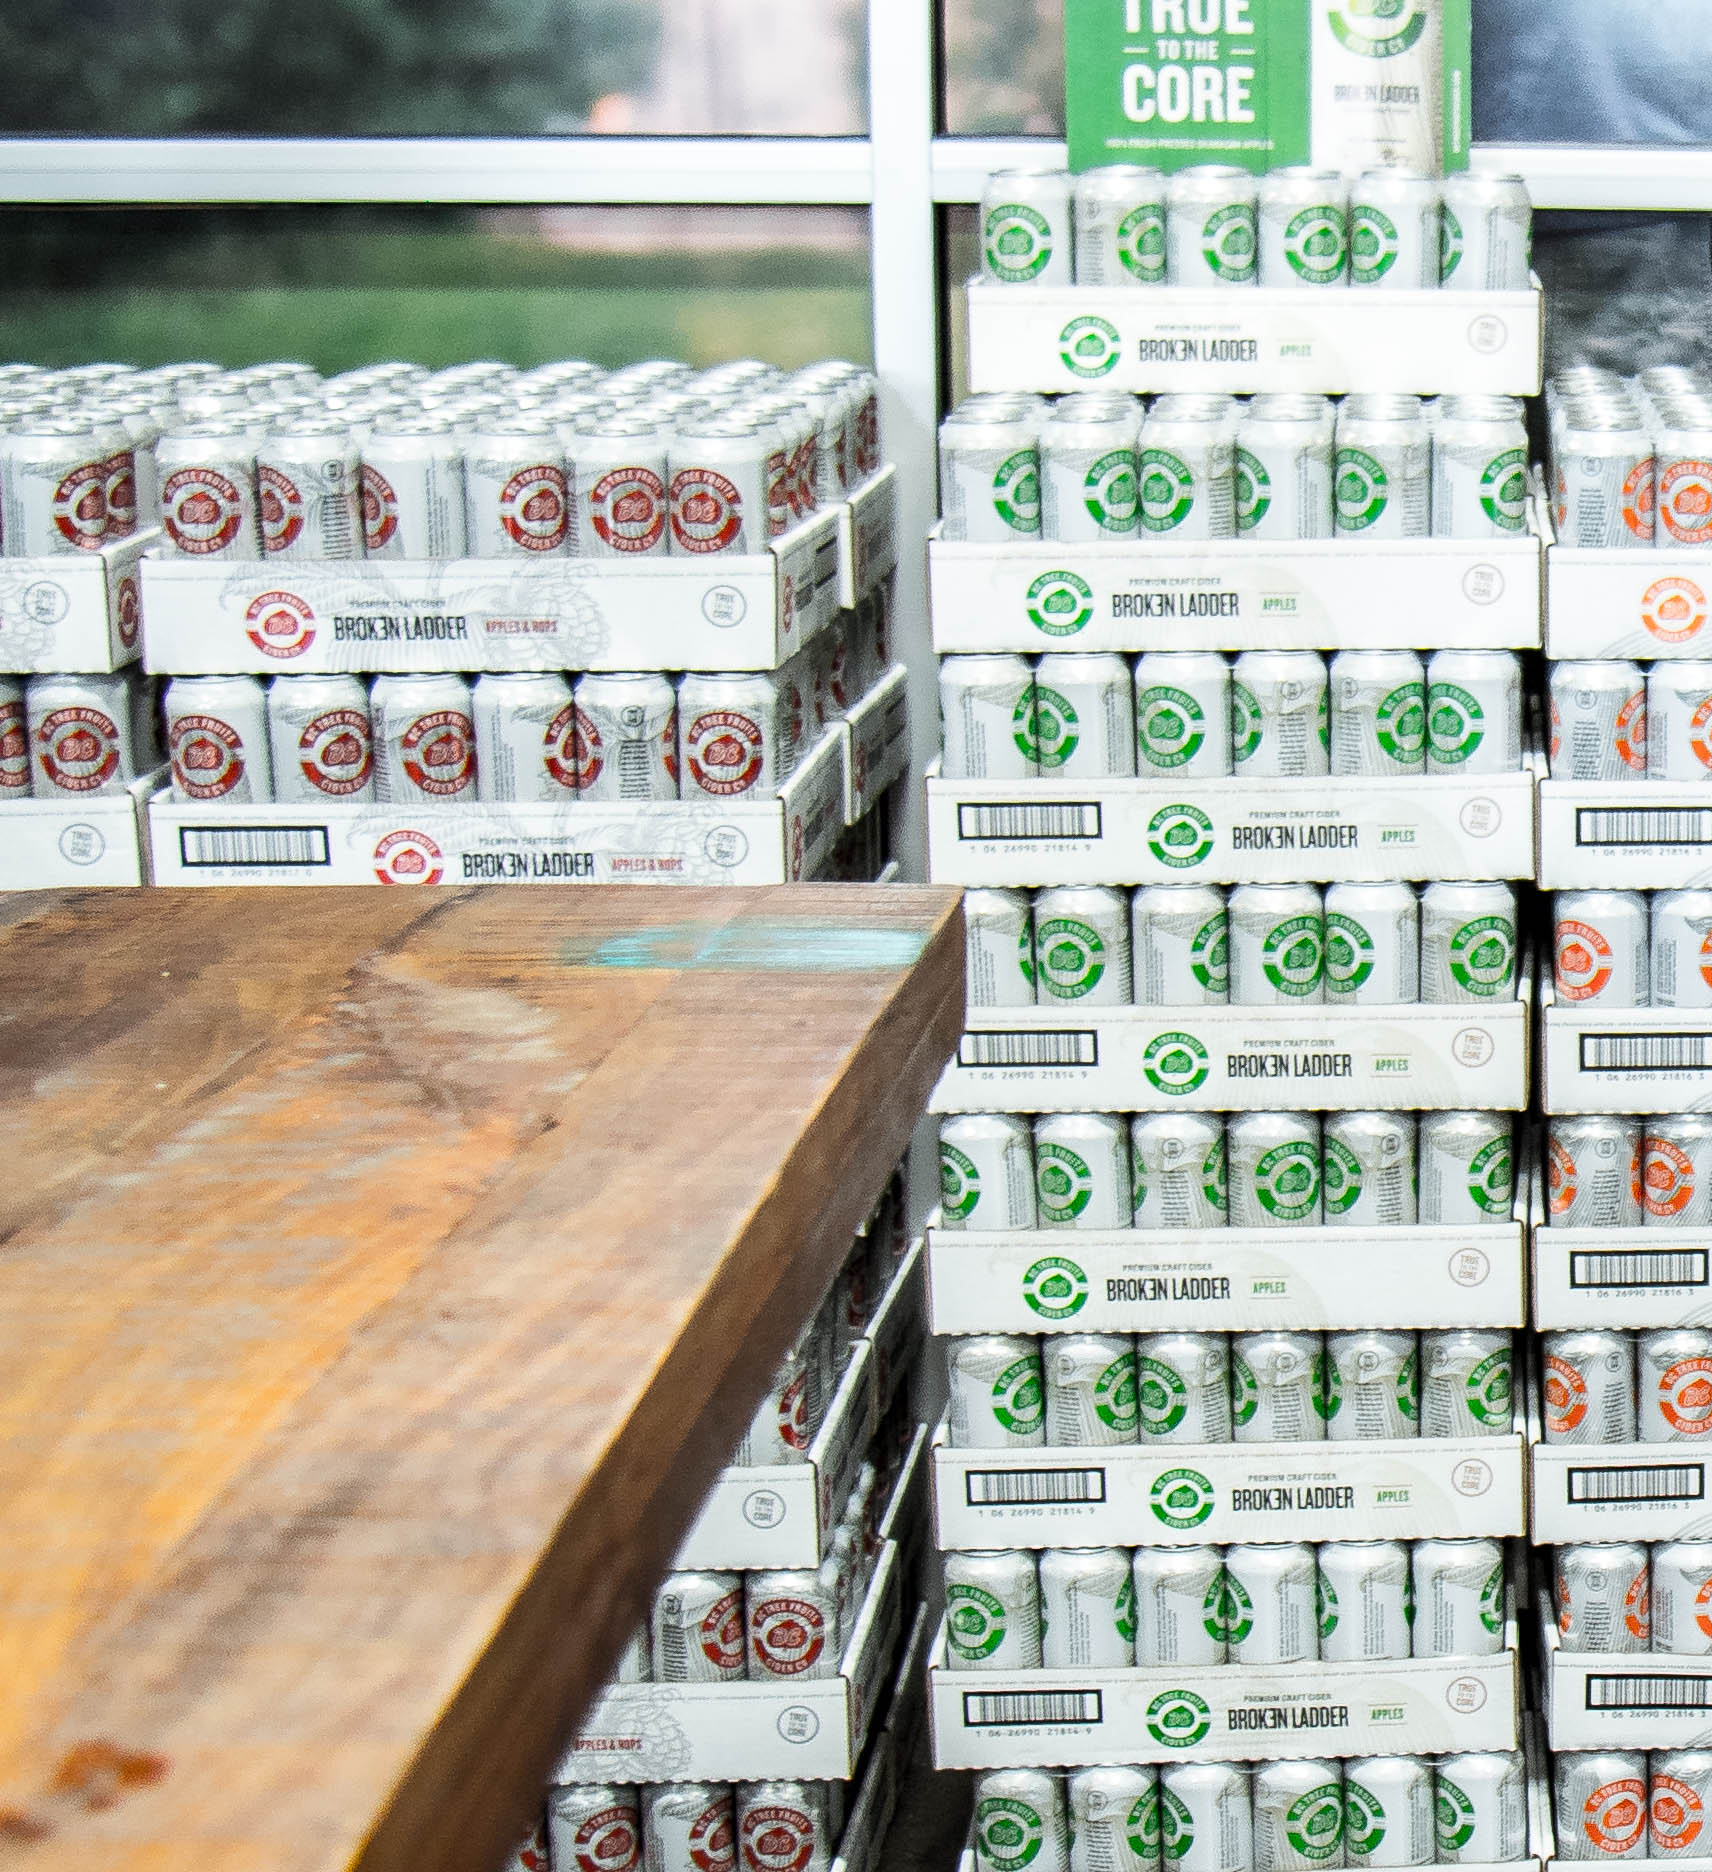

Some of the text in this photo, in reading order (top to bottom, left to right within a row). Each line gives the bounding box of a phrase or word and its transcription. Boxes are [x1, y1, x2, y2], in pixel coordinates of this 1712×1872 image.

[1157, 40, 1219, 60] TO THE
[1122, 63, 1255, 123] CORE
[1203, 339, 1257, 361] LADDER
[1180, 592, 1238, 616] LADDER
[404, 616, 467, 640] LADDER
[1300, 825, 1357, 848] LADDER
[533, 852, 594, 877] LADDER
[1294, 1054, 1351, 1077] LADDER
[1172, 1277, 1230, 1300] LADDER
[1297, 1486, 1353, 1509] LADDER
[1292, 1706, 1348, 1728] LADDER
